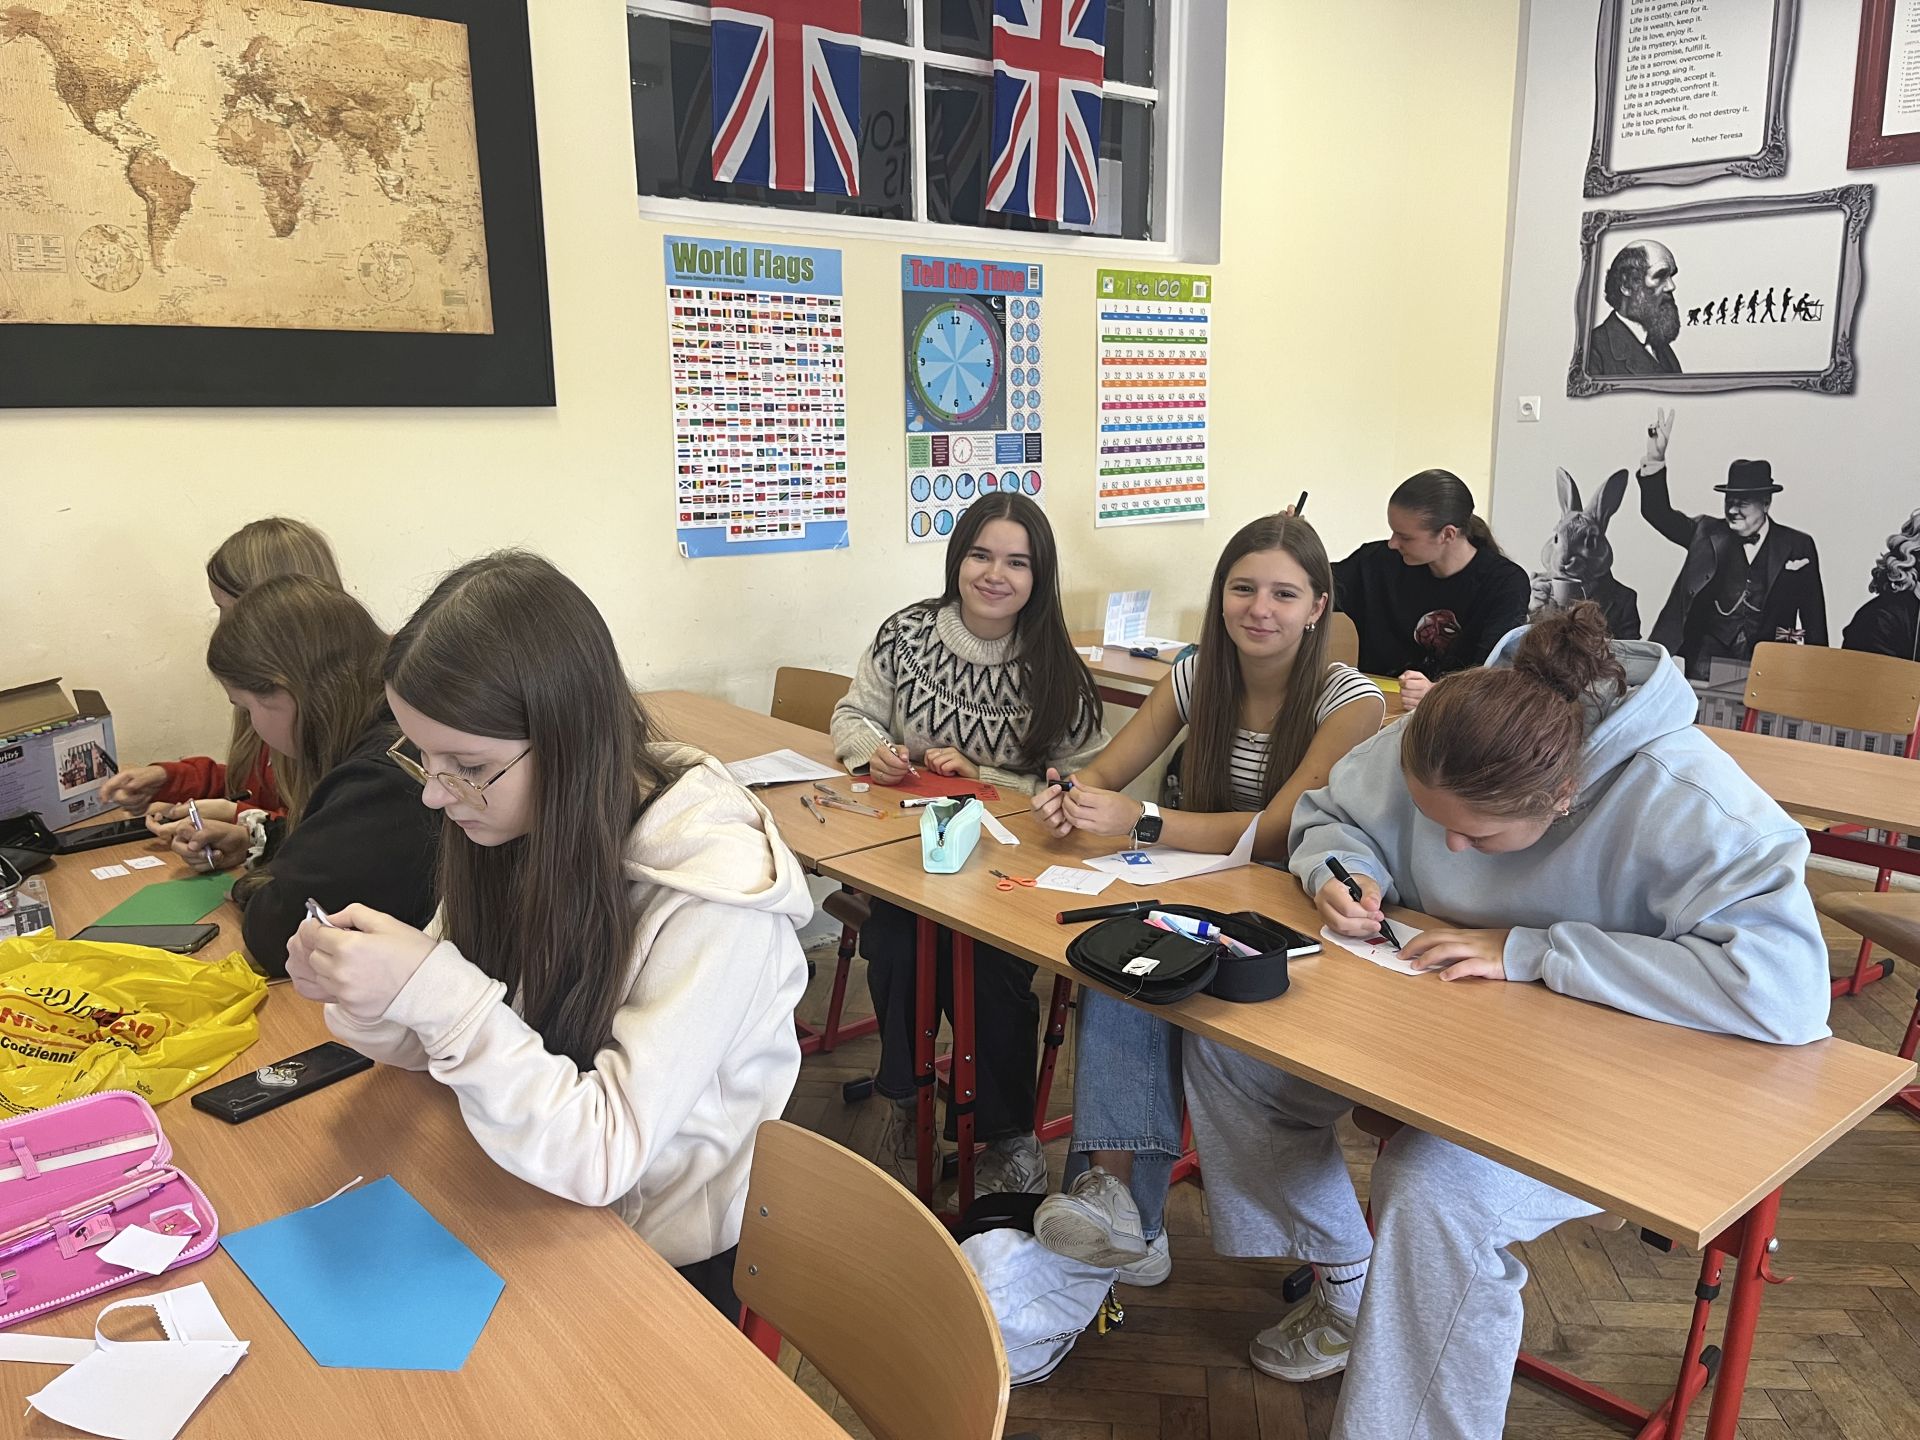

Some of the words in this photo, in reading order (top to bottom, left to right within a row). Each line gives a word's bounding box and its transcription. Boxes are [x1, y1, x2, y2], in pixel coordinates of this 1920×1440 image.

[1631, 7, 1642, 15] Life
[1657, 2, 1678, 10] game,
[1651, 12, 1672, 20] costly,
[1650, 21, 1675, 29] wealth,
[1677, 17, 1694, 25] keep
[1650, 32, 1664, 40] love,
[1666, 28, 1686, 38] enjoy
[1649, 40, 1677, 49] mystery,
[1654, 49, 1683, 59] promise,
[1685, 44, 1703, 52] fulfill
[1653, 59, 1677, 67] sorrow,
[1680, 52, 1714, 63] overcome
[1672, 66, 1687, 74] sing
[1651, 77, 1682, 87] struggle,
[1684, 73, 1708, 82] accept
[1651, 86, 1679, 96] tragedy,
[1680, 82, 1710, 92] confront
[1654, 95, 1691, 105] adventure,
[1655, 114, 1686, 125] precious,
[1714, 107, 1740, 116] destroy
[1657, 126, 1674, 134] fight
[1692, 135, 1717, 143] Mother
[1720, 132, 1743, 140] Teresa
[672, 243, 747, 277] World
[753, 248, 814, 284] Flags
[911, 258, 945, 288] Tell
[948, 262, 978, 290] the
[981, 264, 1025, 292] Time
[1135, 283, 1149, 296] to
[1154, 279, 1181, 298] 100
[951, 316, 960, 324] 12
[920, 358, 926, 366] 9
[986, 359, 991, 367] 3
[954, 399, 959, 407] 6
[0, 1036, 78, 1064] Codzienni
